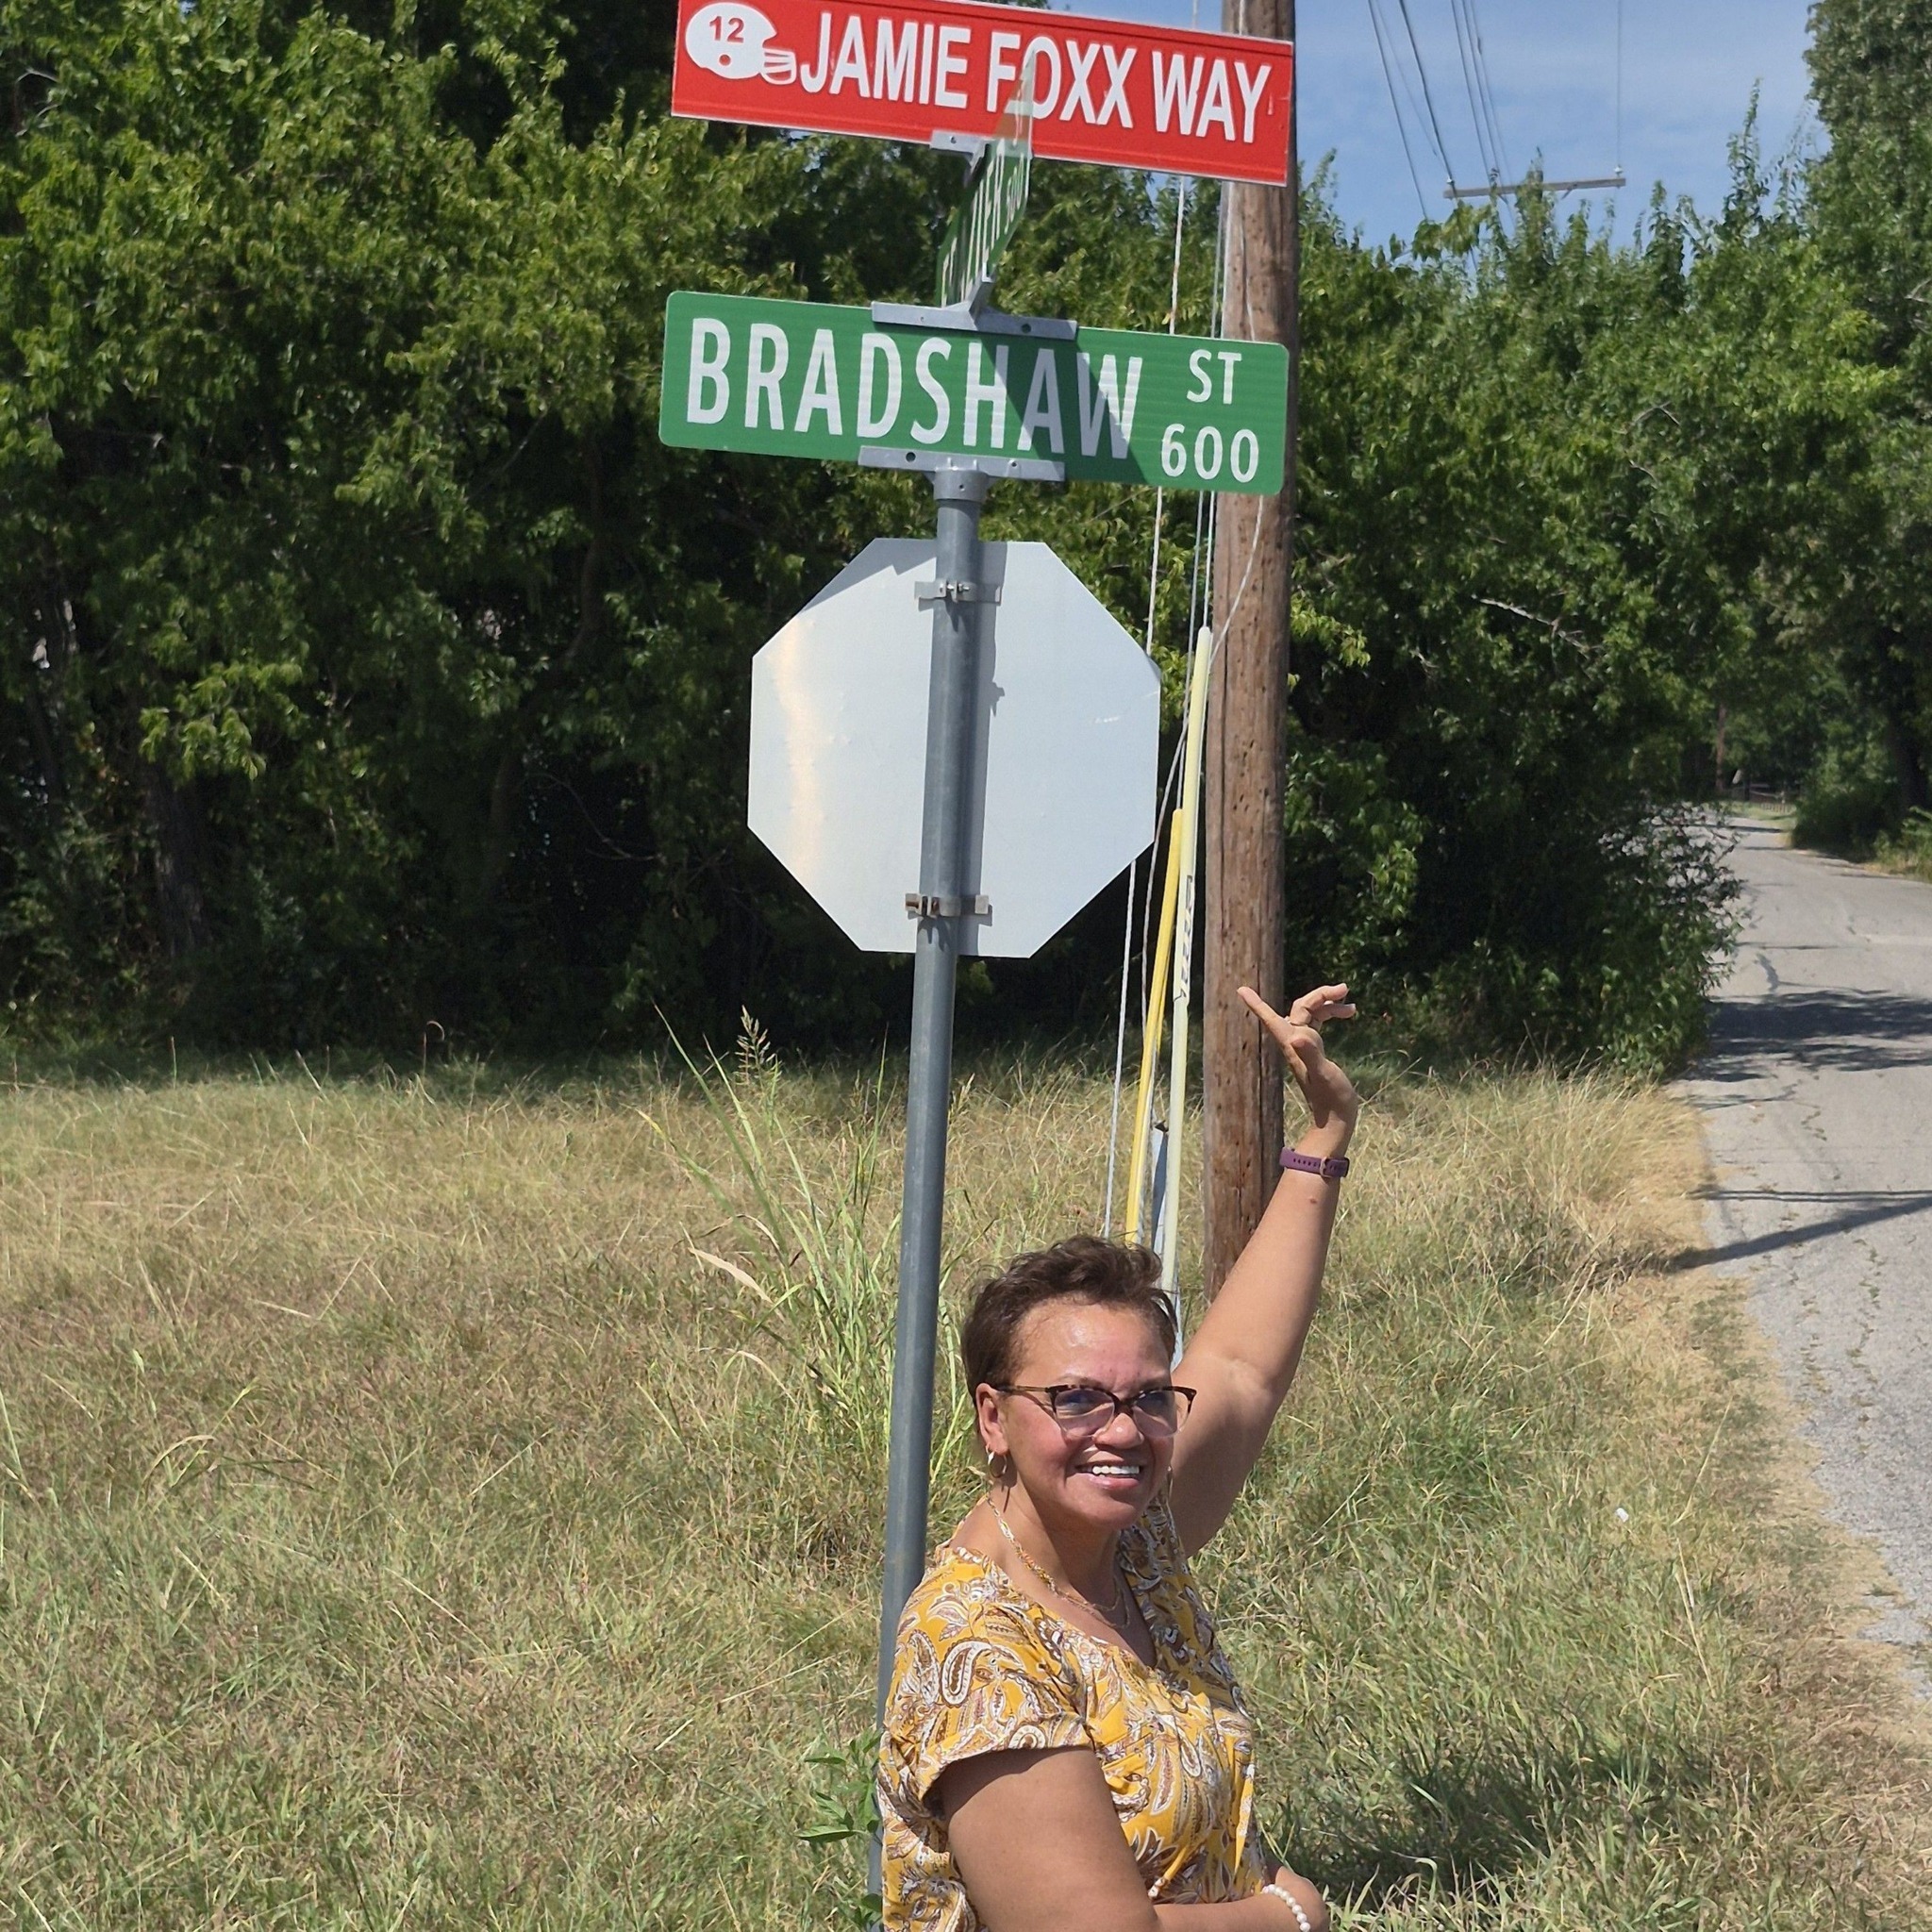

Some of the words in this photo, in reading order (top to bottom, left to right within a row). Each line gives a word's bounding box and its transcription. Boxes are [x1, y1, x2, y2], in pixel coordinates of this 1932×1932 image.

[709, 16, 744, 43] 12
[800, 12, 971, 108] JAMIE
[987, 31, 1138, 129] FOXX
[1152, 51, 1271, 143] WAY
[686, 317, 1142, 459] BRADSHAW
[1186, 349, 1242, 405] ST
[1160, 423, 1260, 483] 600
